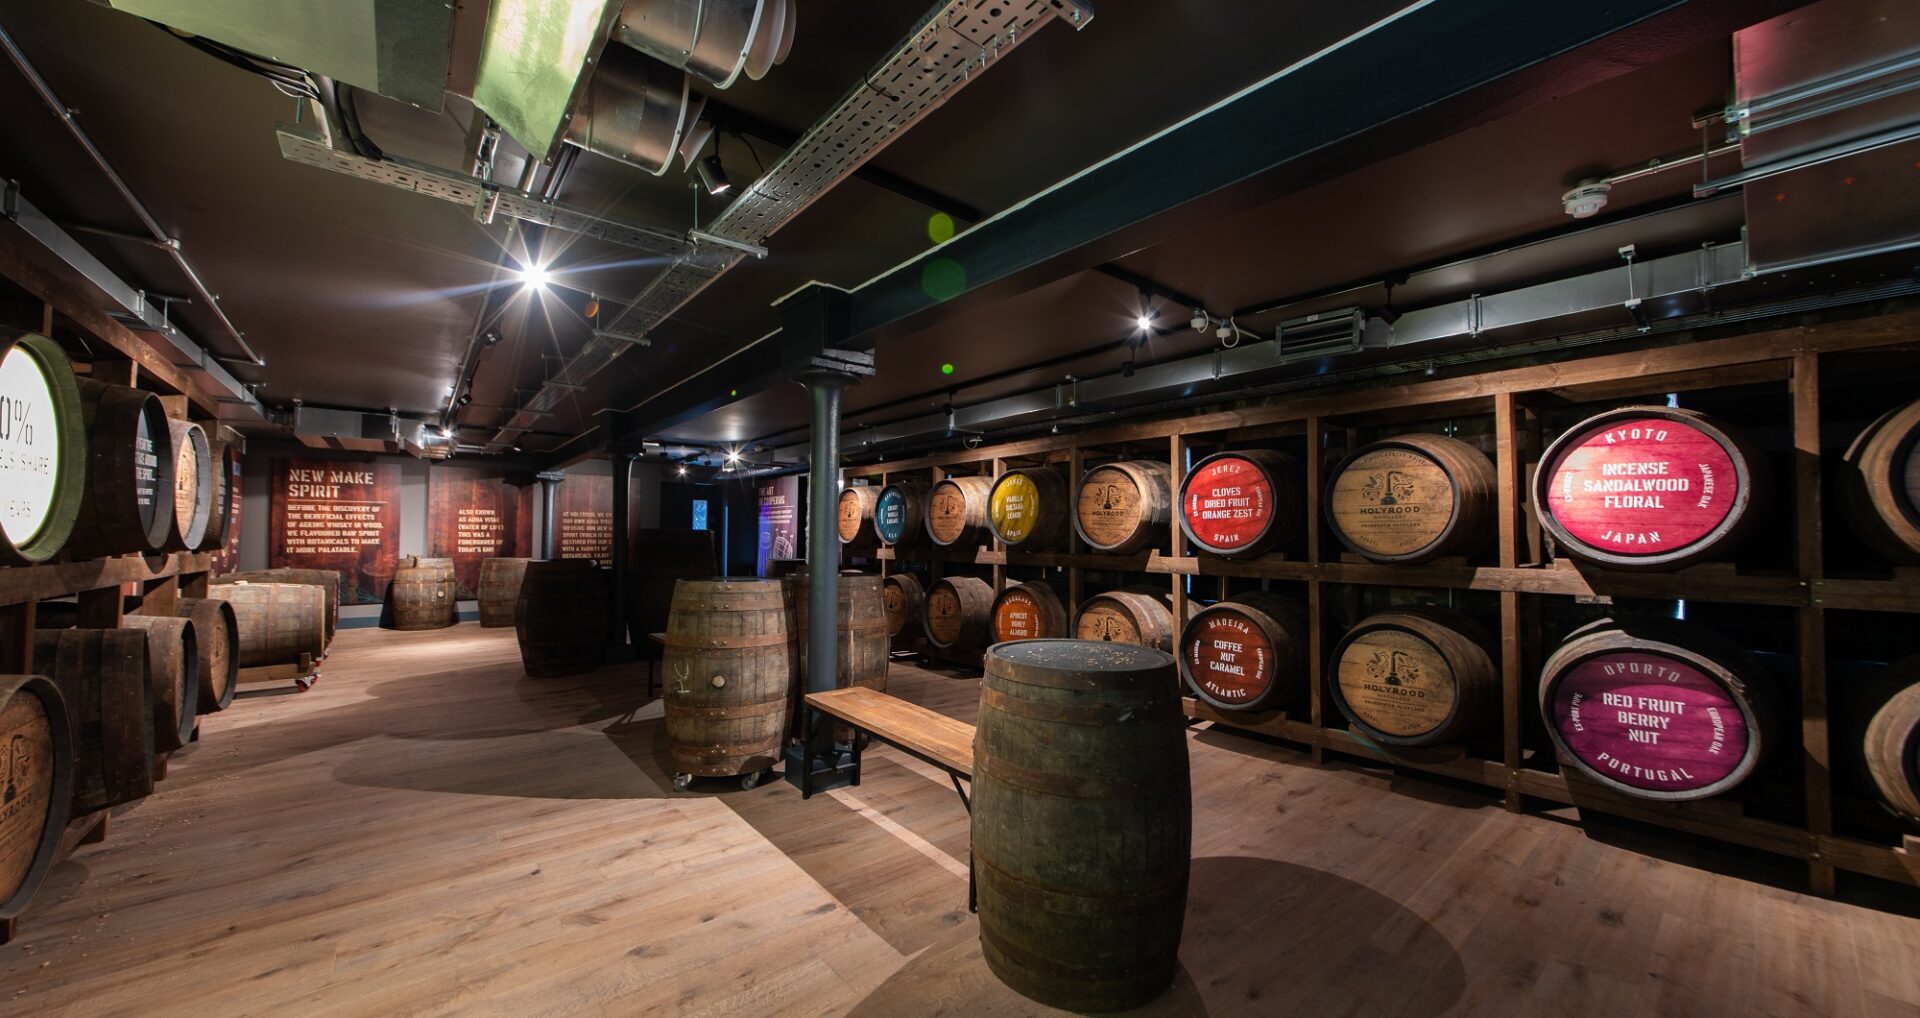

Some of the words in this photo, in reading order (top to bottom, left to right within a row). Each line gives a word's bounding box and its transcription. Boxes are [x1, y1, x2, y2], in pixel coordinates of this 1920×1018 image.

[1604, 428, 1668, 444] KYOTO
[1212, 465, 1240, 476] JEREZ
[1602, 461, 1669, 476] INCENSE
[290, 469, 324, 482] NEW
[331, 471, 374, 484] MAKE
[1699, 463, 1714, 495] JAPANESE
[289, 484, 340, 498] SPIRIT
[1212, 487, 1241, 497] CLOVES
[1584, 478, 1690, 493] SANDALWOOD
[1205, 499, 1226, 509] DRIED
[1228, 497, 1250, 507] FRUIT
[1604, 495, 1664, 509] FLORAL
[1697, 496, 1711, 509] OAK
[1202, 510, 1231, 519] ORANGE
[1233, 509, 1253, 518] ZEST
[1360, 506, 1421, 515] HOLYROOD
[1214, 534, 1240, 543] SPAIN
[1601, 530, 1661, 544] JAPAN
[1209, 618, 1249, 634] MADEIRA
[1214, 640, 1243, 652] COFFEE
[1220, 652, 1235, 662] NUT
[1210, 661, 1245, 676] CARAMEL
[1604, 663, 1681, 682] OPORTO
[1206, 680, 1246, 698] ATLANTIC
[1364, 684, 1425, 698] HOLYROOD
[1602, 692, 1633, 708] RED
[1638, 697, 1685, 715] FRUIT
[1618, 711, 1670, 730] BERRY
[1707, 707, 1725, 741] EUROPEAN
[1628, 729, 1660, 744] NUT
[1708, 741, 1723, 755] OAK
[1597, 753, 1694, 782] PORTUGAL
